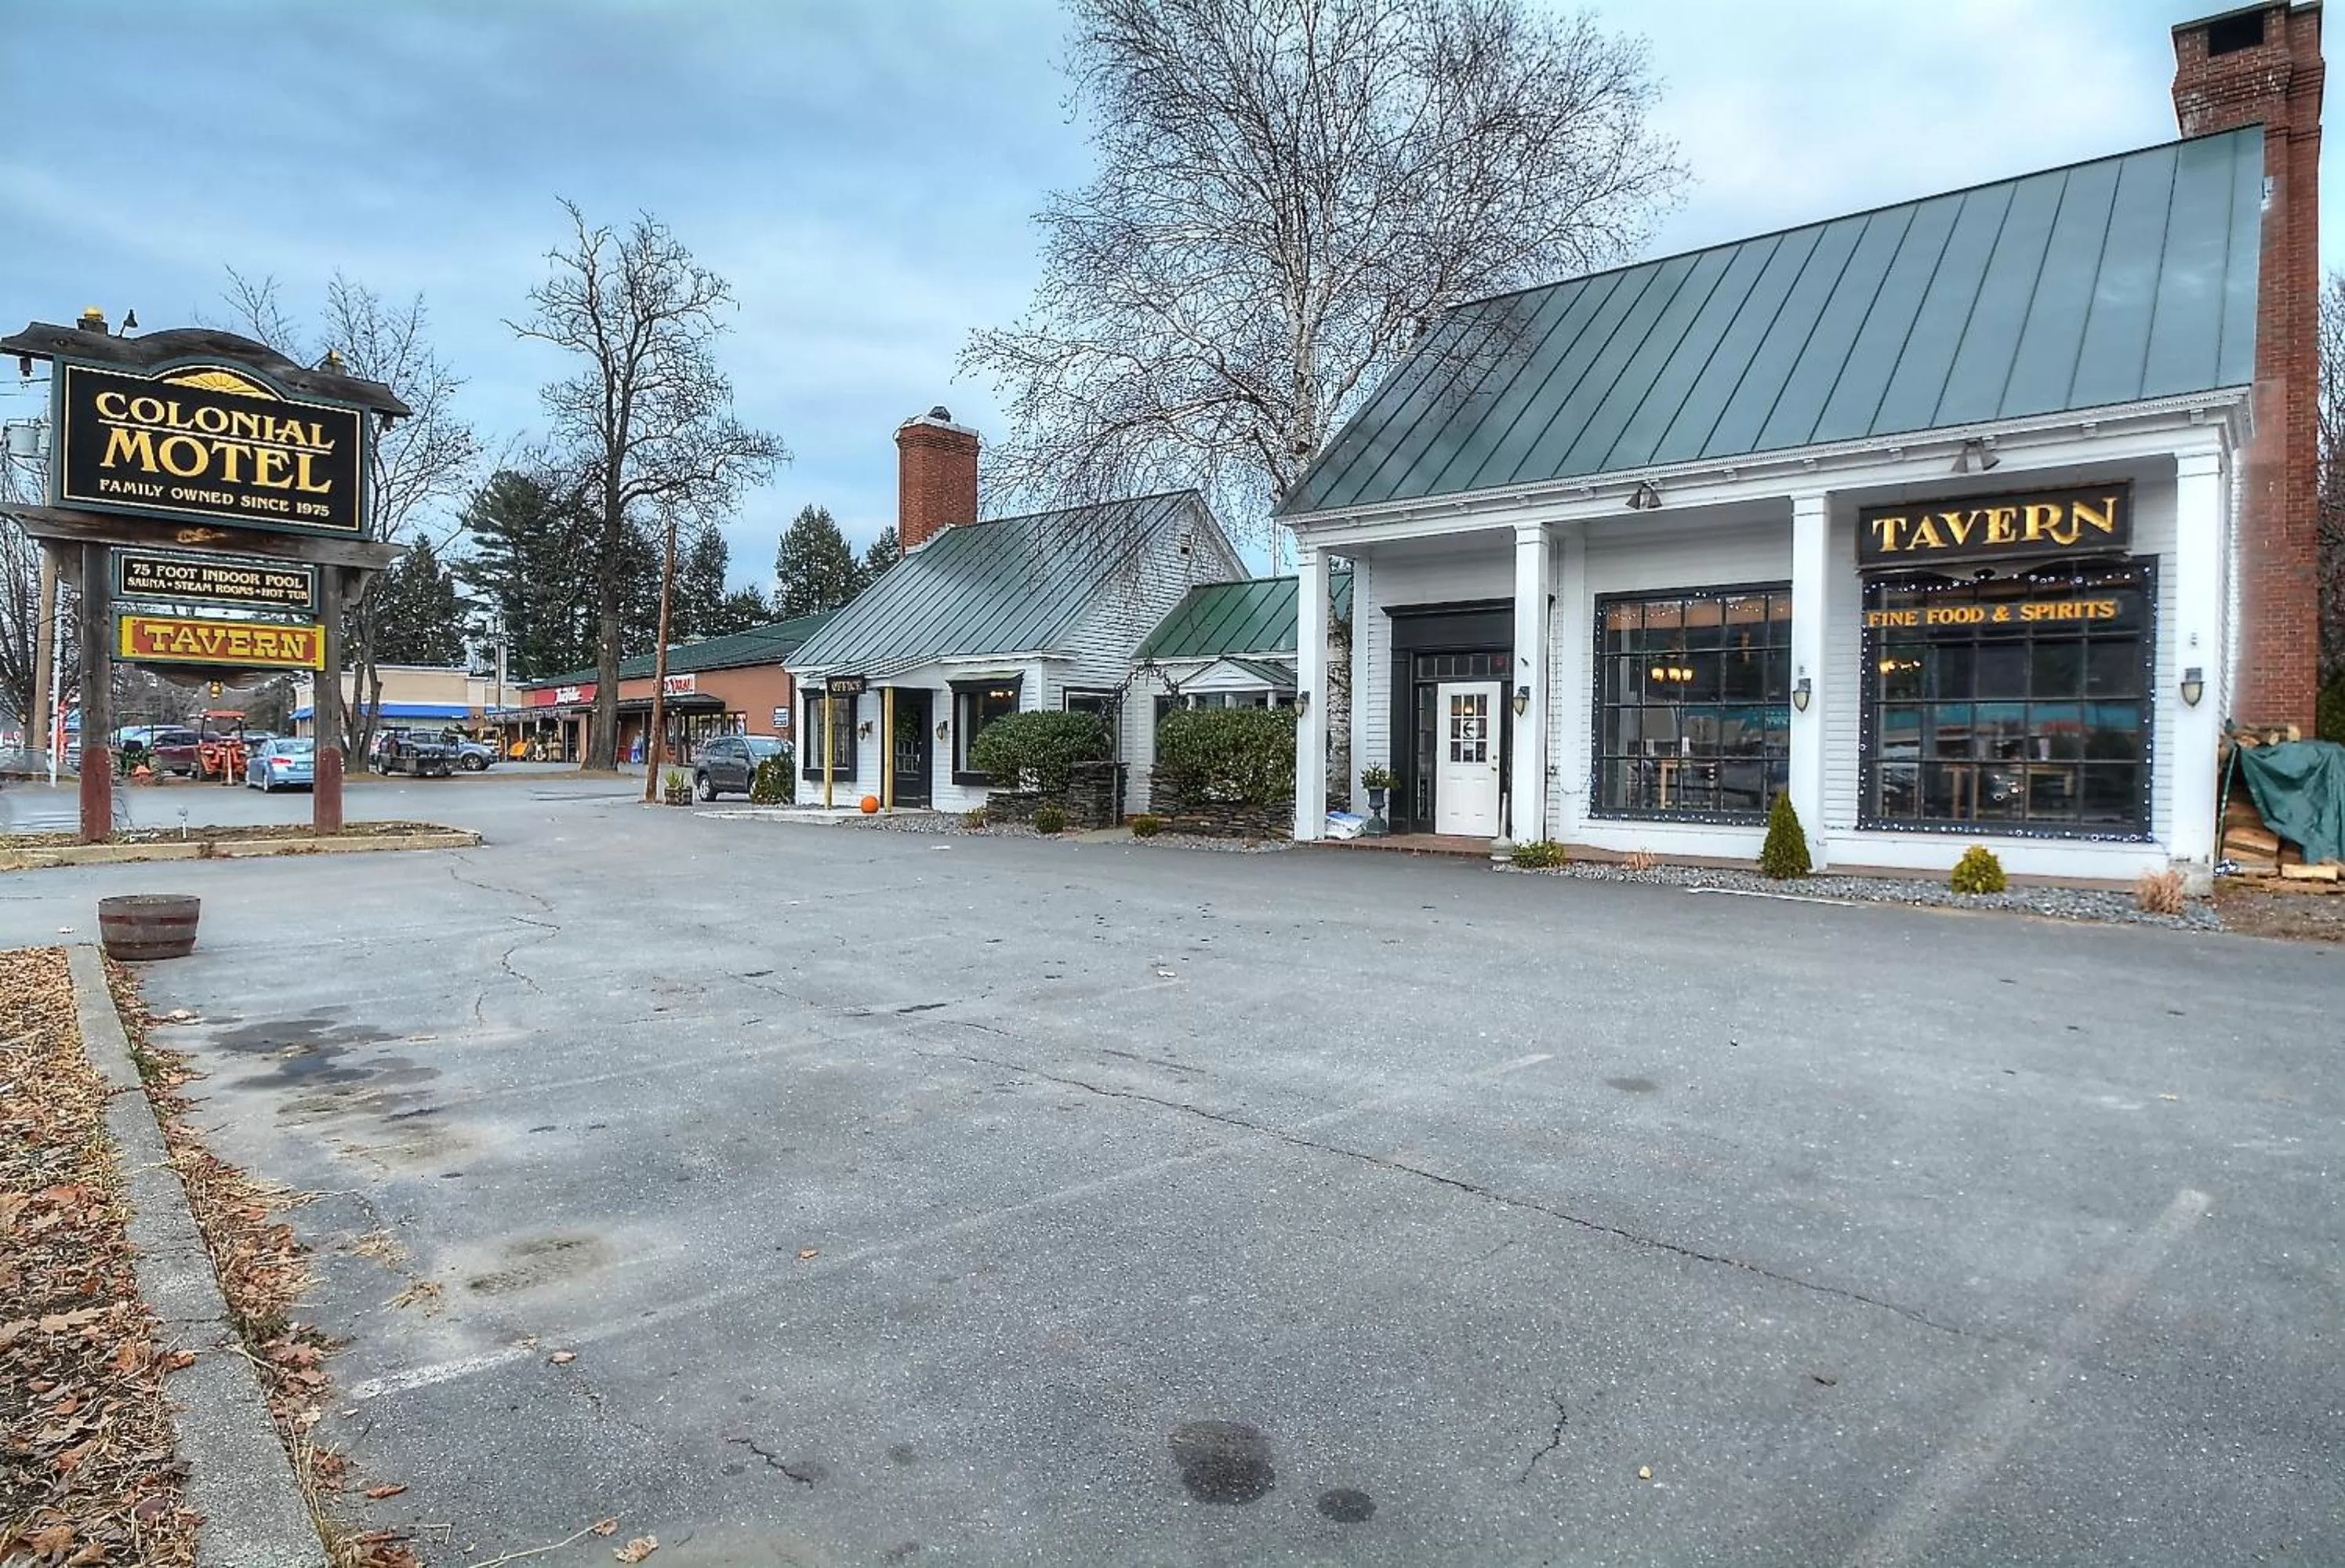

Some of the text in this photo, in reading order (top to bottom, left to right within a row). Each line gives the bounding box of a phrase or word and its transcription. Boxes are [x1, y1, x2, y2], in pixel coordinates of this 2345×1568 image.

[96, 392, 335, 449] COLONIAL
[100, 427, 332, 493] MOTEL
[100, 479, 330, 517] FAMILY OWNED SINCE 1975
[1872, 496, 2117, 552] TAVERN
[128, 577, 165, 588] SAUNA
[174, 581, 212, 592] STEAM
[216, 584, 253, 596] ROOMS
[261, 589, 284, 598] HOT
[132, 564, 303, 588] 75 FOOT INDOOR POOL
[1868, 600, 2115, 626] FINE FOOD & SPIRITS
[144, 625, 307, 659] TAVERN
